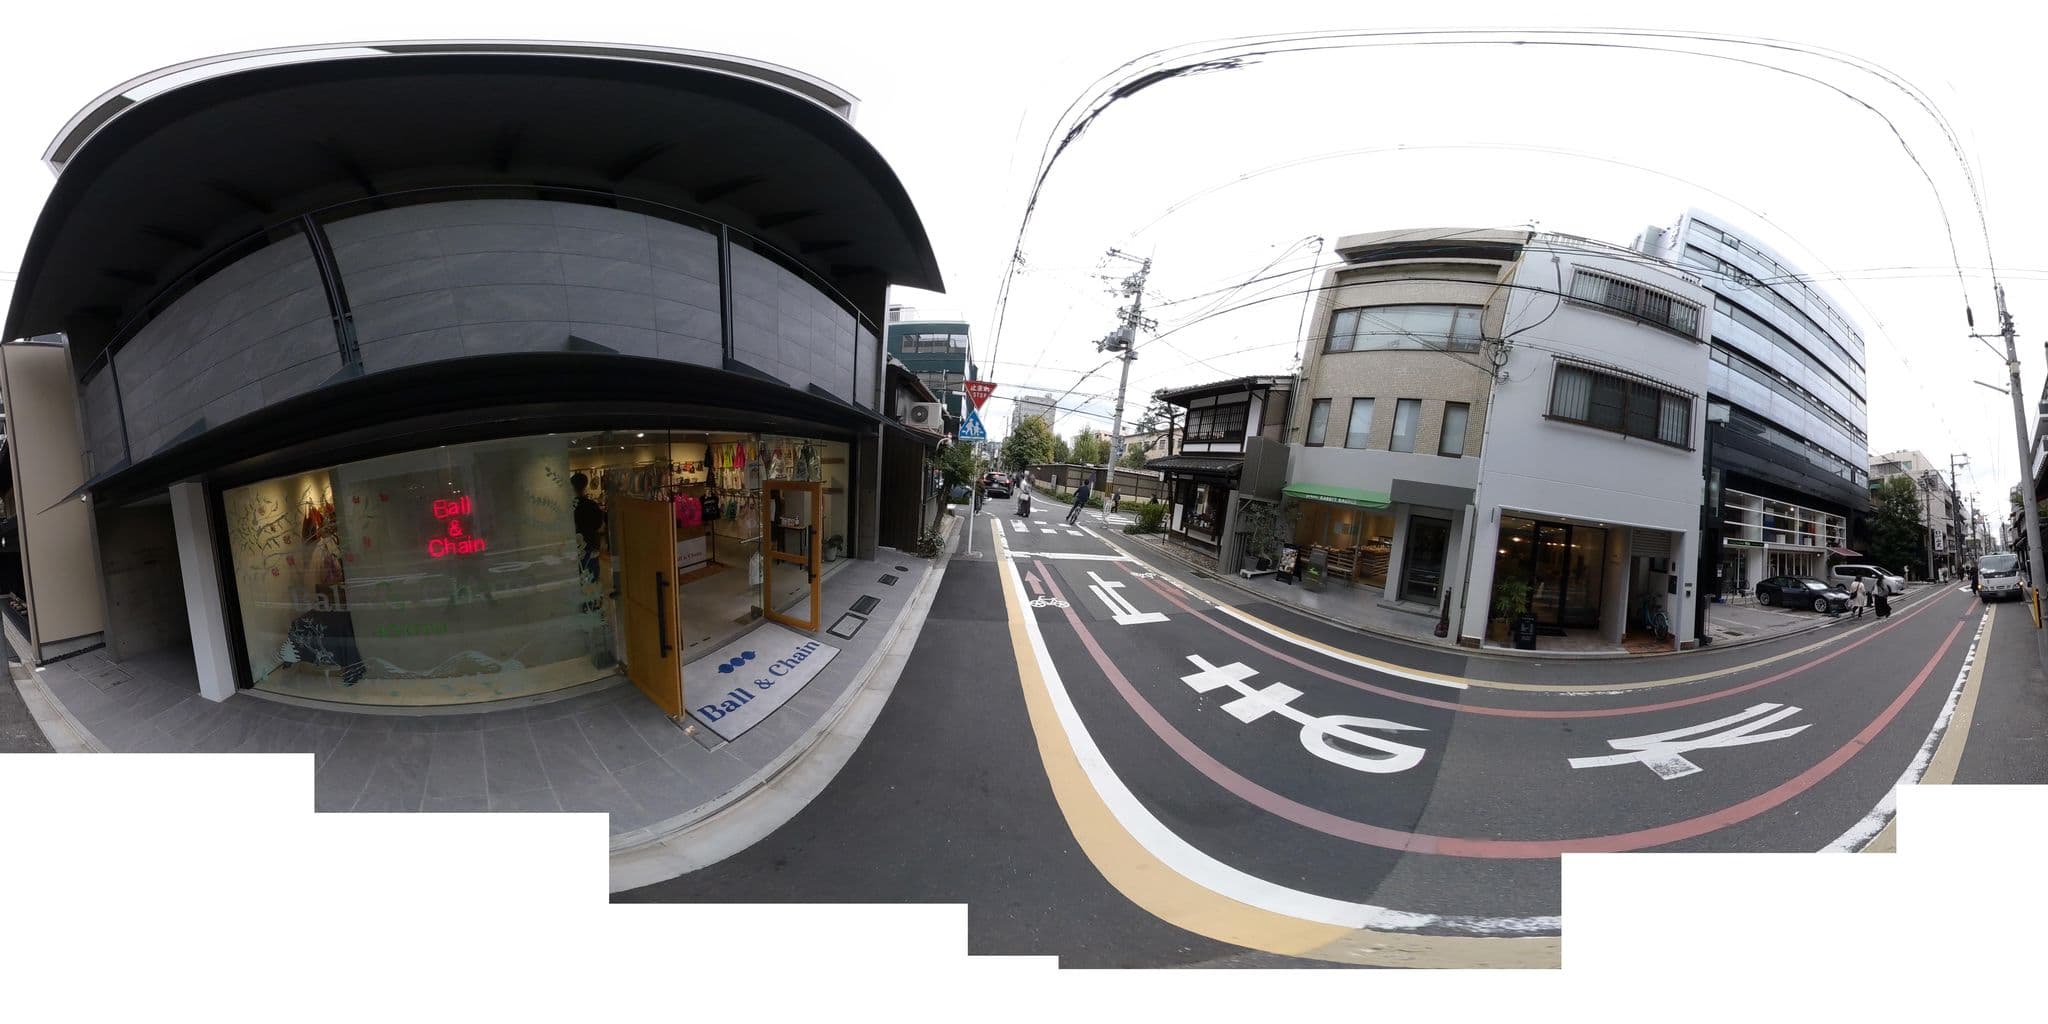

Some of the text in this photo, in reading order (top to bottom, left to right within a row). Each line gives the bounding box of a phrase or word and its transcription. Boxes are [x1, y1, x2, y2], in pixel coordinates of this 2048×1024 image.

[433, 496, 471, 518] Ball
[449, 520, 463, 537] &
[428, 536, 486, 558] Chain
[697, 641, 820, 722] Ball & Chain
